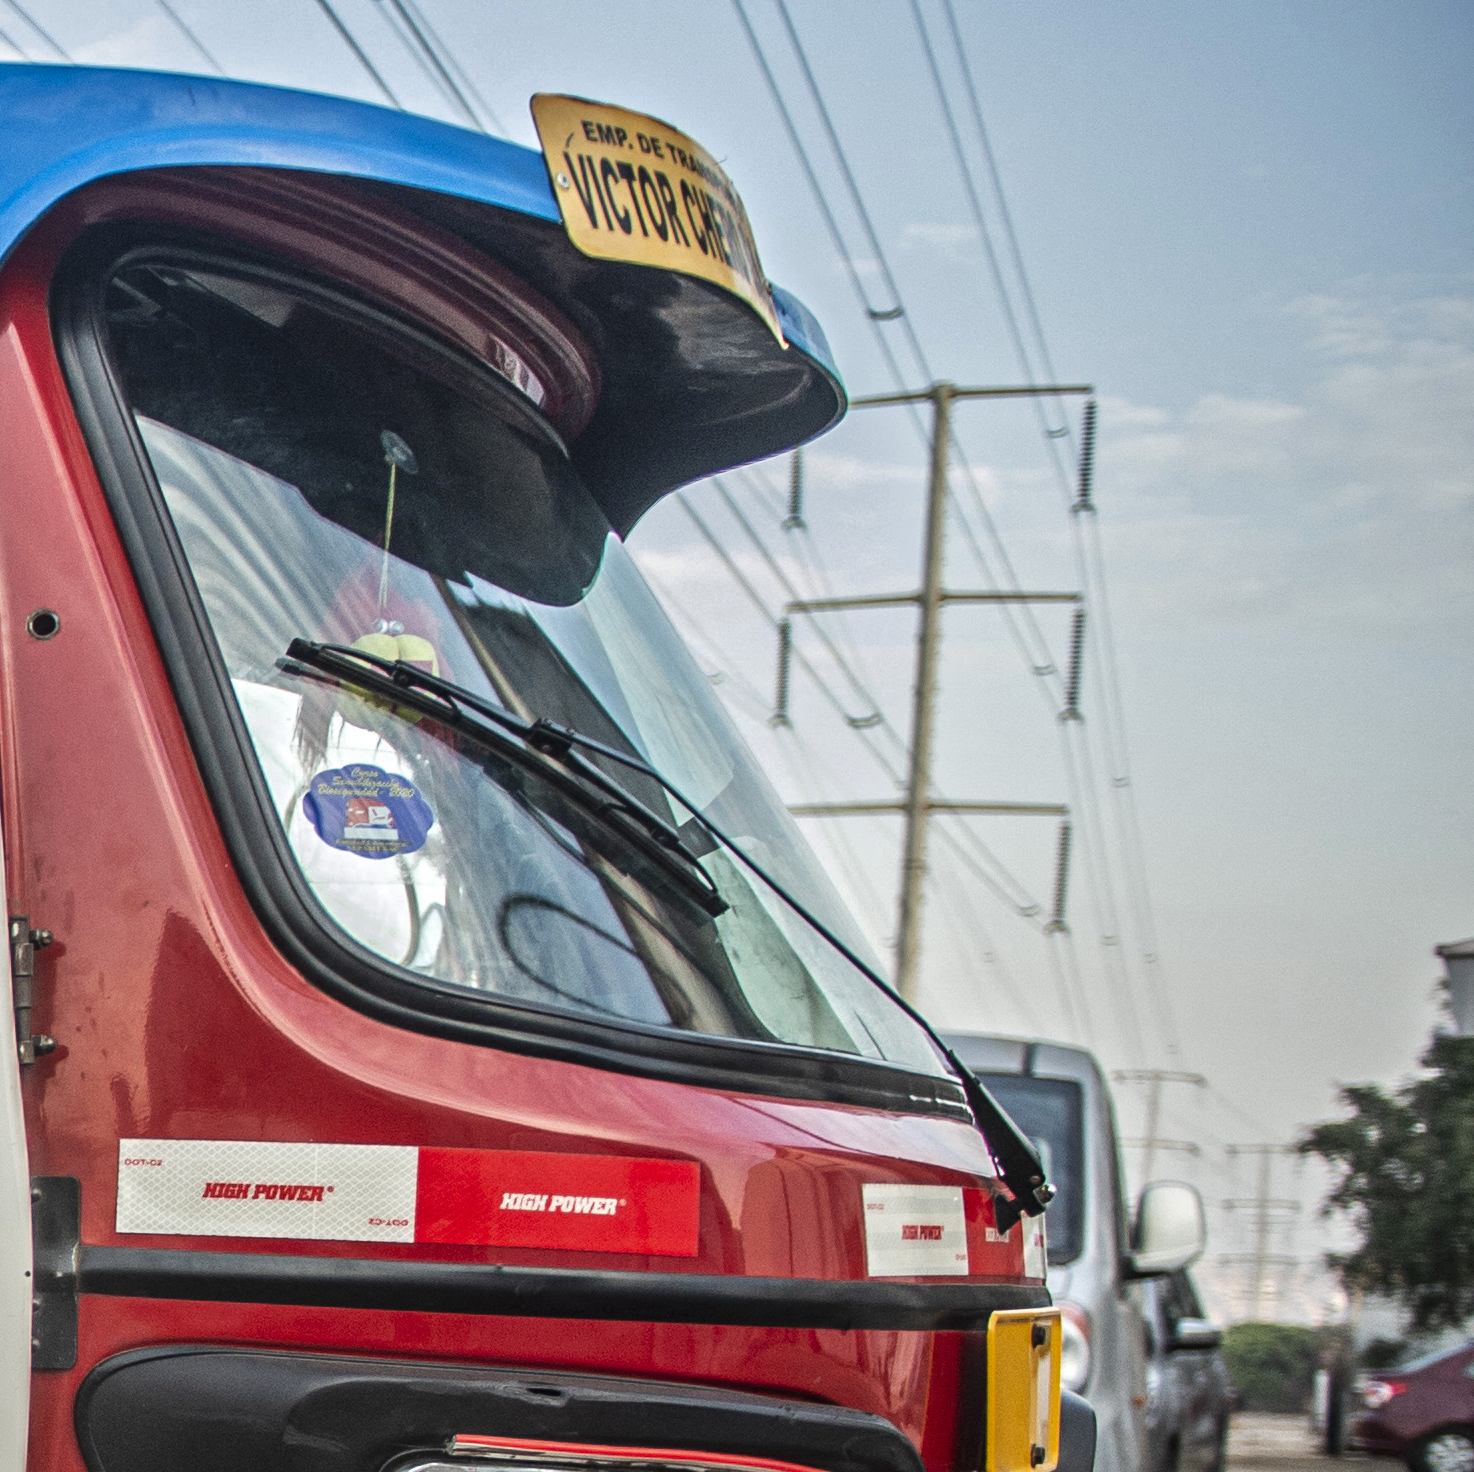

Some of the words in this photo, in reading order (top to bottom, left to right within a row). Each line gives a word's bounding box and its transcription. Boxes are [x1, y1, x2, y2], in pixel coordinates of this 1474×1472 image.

[581, 120, 633, 150] EMP.
[636, 133, 666, 160] DE
[563, 151, 691, 248] VICTOR
[202, 1182, 251, 1200] HIGH
[252, 1184, 325, 1201] POWER
[500, 1193, 549, 1211] HIGH
[549, 1196, 618, 1215] POWER
